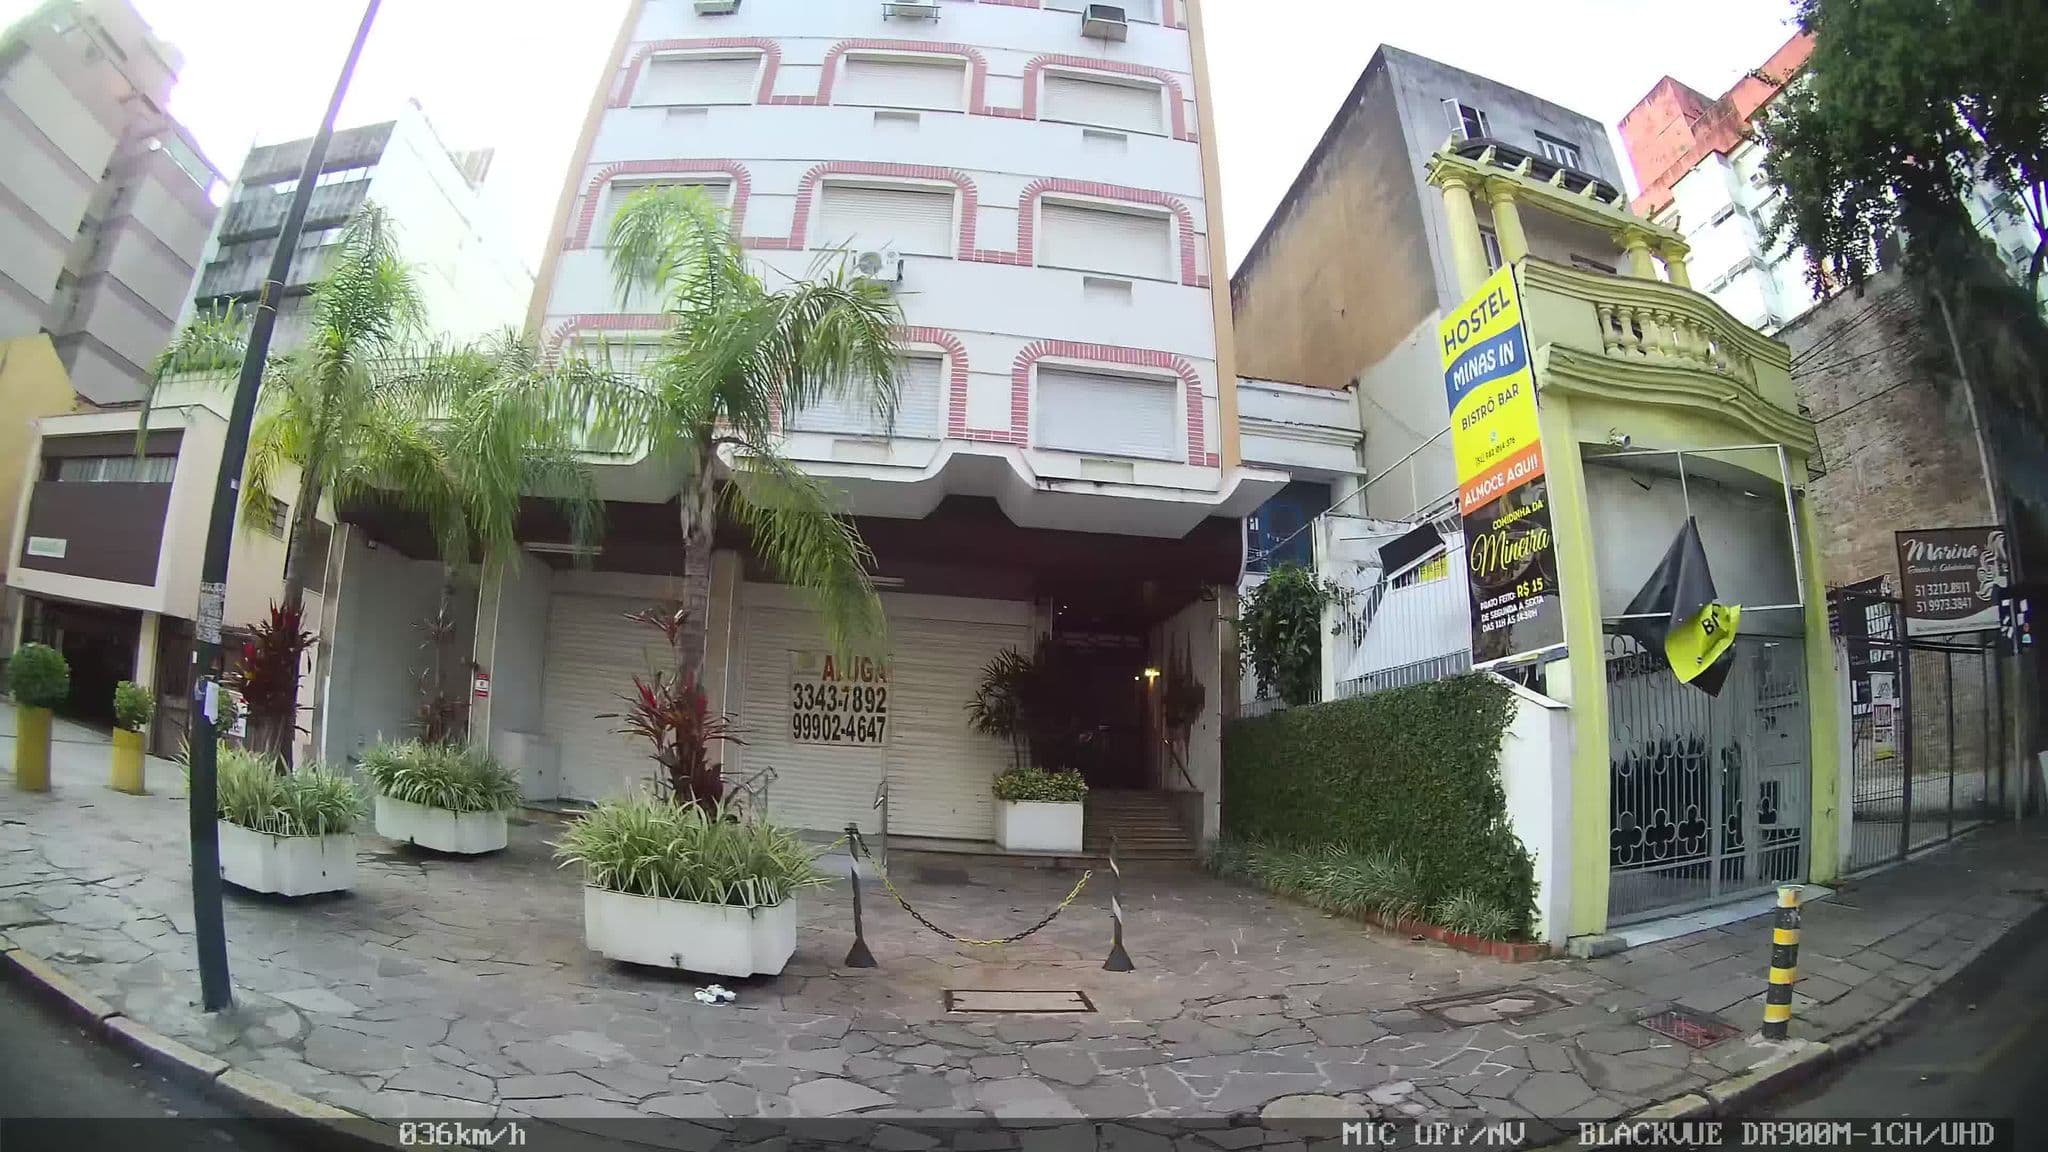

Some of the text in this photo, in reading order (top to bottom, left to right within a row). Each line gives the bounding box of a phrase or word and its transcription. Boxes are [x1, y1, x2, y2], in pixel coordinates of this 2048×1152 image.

[1444, 287, 1510, 356] HOSTEL
[1453, 340, 1514, 391] MINAS IN
[1461, 383, 1519, 431] BISTRÔ BAR
[1464, 472, 1504, 507] ALMOCE
[1492, 500, 1544, 531] COMIDINHA DA
[1470, 528, 1550, 577] Mineira
[1903, 538, 1979, 561] Marina
[1516, 580, 1530, 598] R$
[1532, 577, 1544, 593] 15
[1915, 584, 1925, 597] 51
[1481, 596, 1544, 622] DE SEGUNDA A SEXTA
[1916, 600, 1927, 613] 51
[1482, 622, 1494, 633] DAS
[793, 683, 887, 713] 3343-7892
[793, 713, 886, 743] 99902-4647
